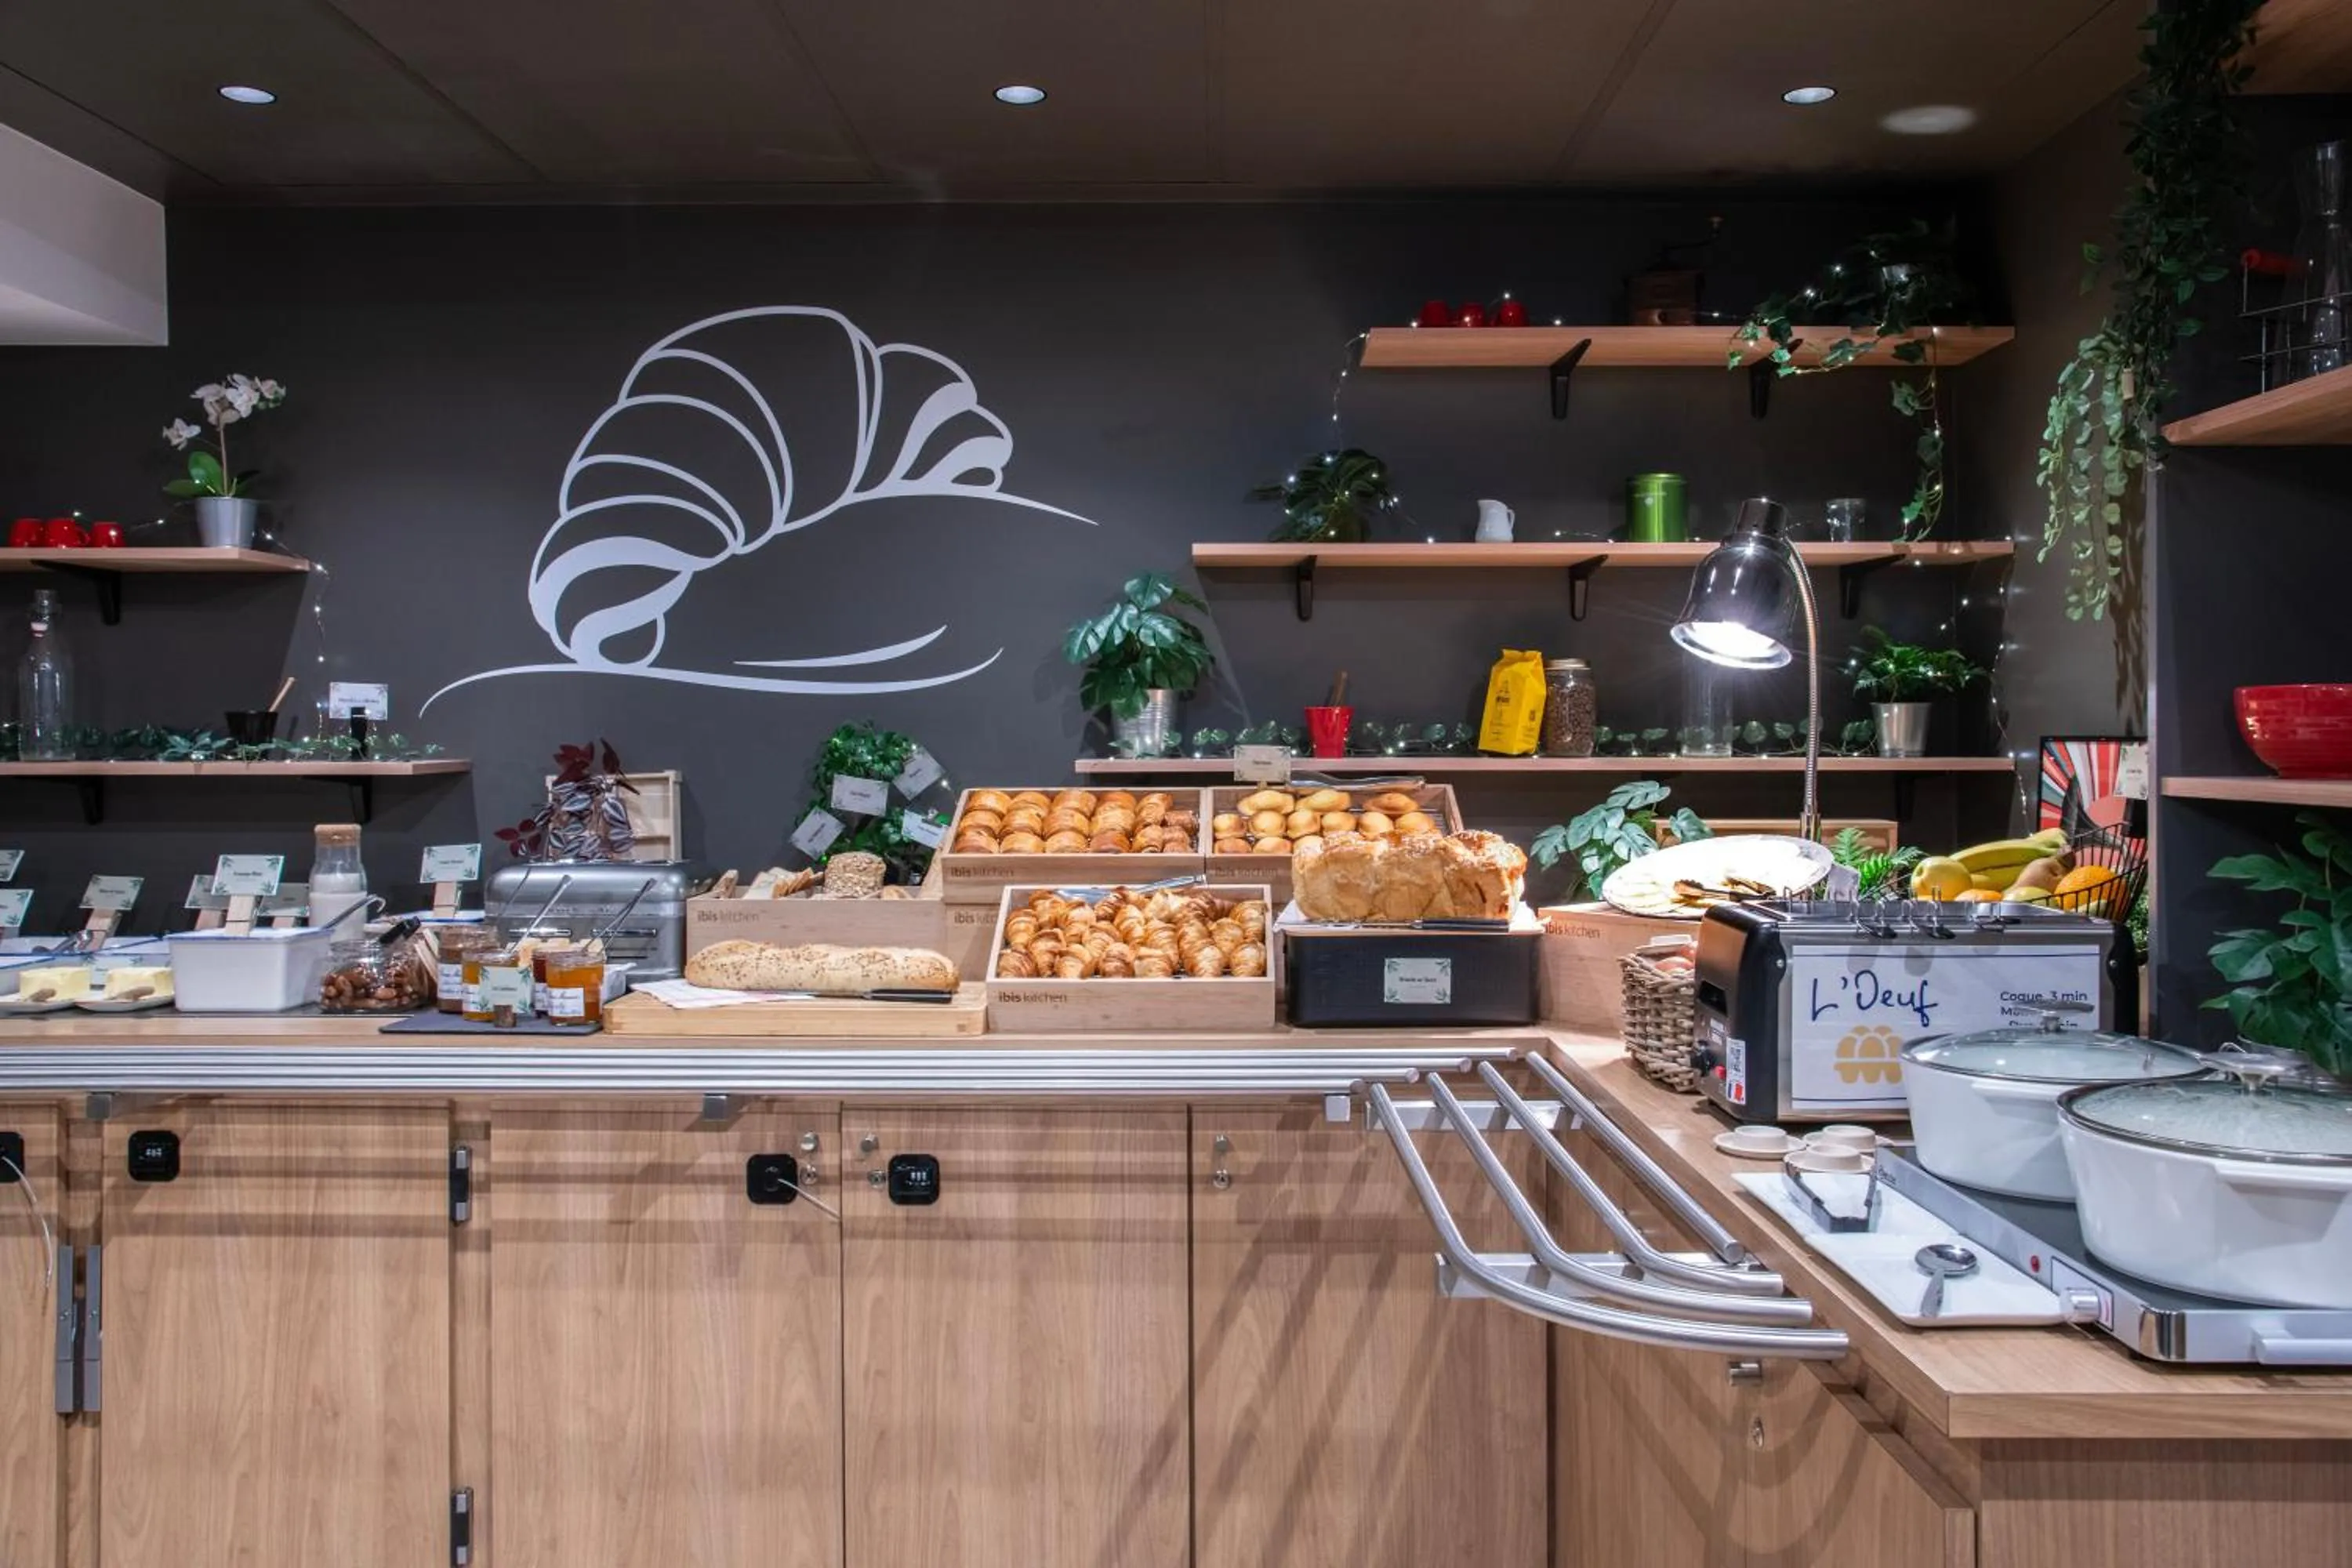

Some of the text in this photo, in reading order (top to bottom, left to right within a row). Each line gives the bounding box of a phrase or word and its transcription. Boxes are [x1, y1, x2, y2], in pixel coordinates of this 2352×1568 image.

[951, 866, 1014, 877] ibis kitchen
[697, 909, 760, 923] ibis kitchen
[954, 912, 975, 924] ibis
[1544, 921, 1601, 938] ibis kitchen
[999, 991, 1067, 1003] ibis kitchen
[2062, 990, 2088, 1001] min
